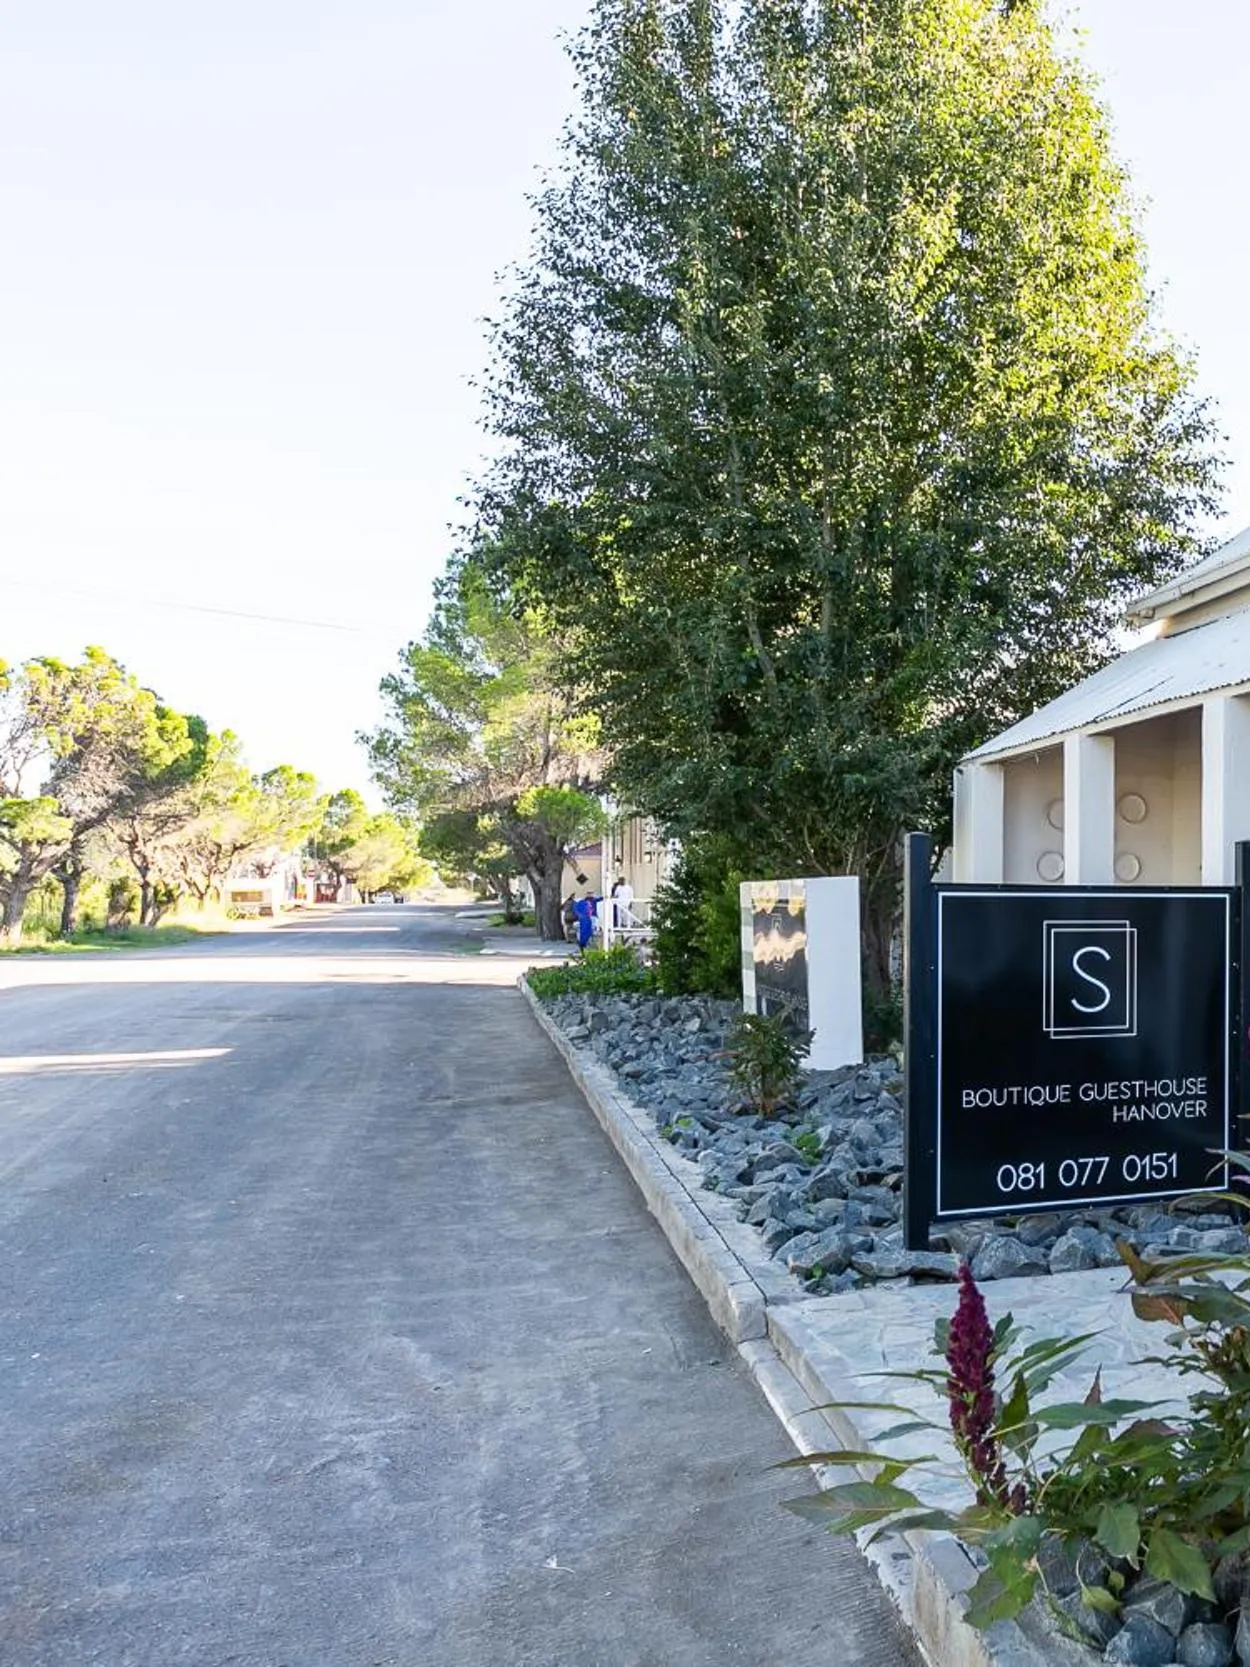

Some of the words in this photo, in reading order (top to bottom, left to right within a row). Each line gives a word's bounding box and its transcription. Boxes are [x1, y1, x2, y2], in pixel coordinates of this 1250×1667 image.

[1071, 946, 1111, 1013] S
[962, 1084, 1072, 1108] BOUTIQUE
[1079, 1077, 1208, 1102] GUESTHOUSE
[1113, 1100, 1208, 1123] HANOVER
[996, 1162, 1045, 1193] 081
[1058, 1156, 1110, 1187] 077
[1122, 1152, 1178, 1182] 0151
